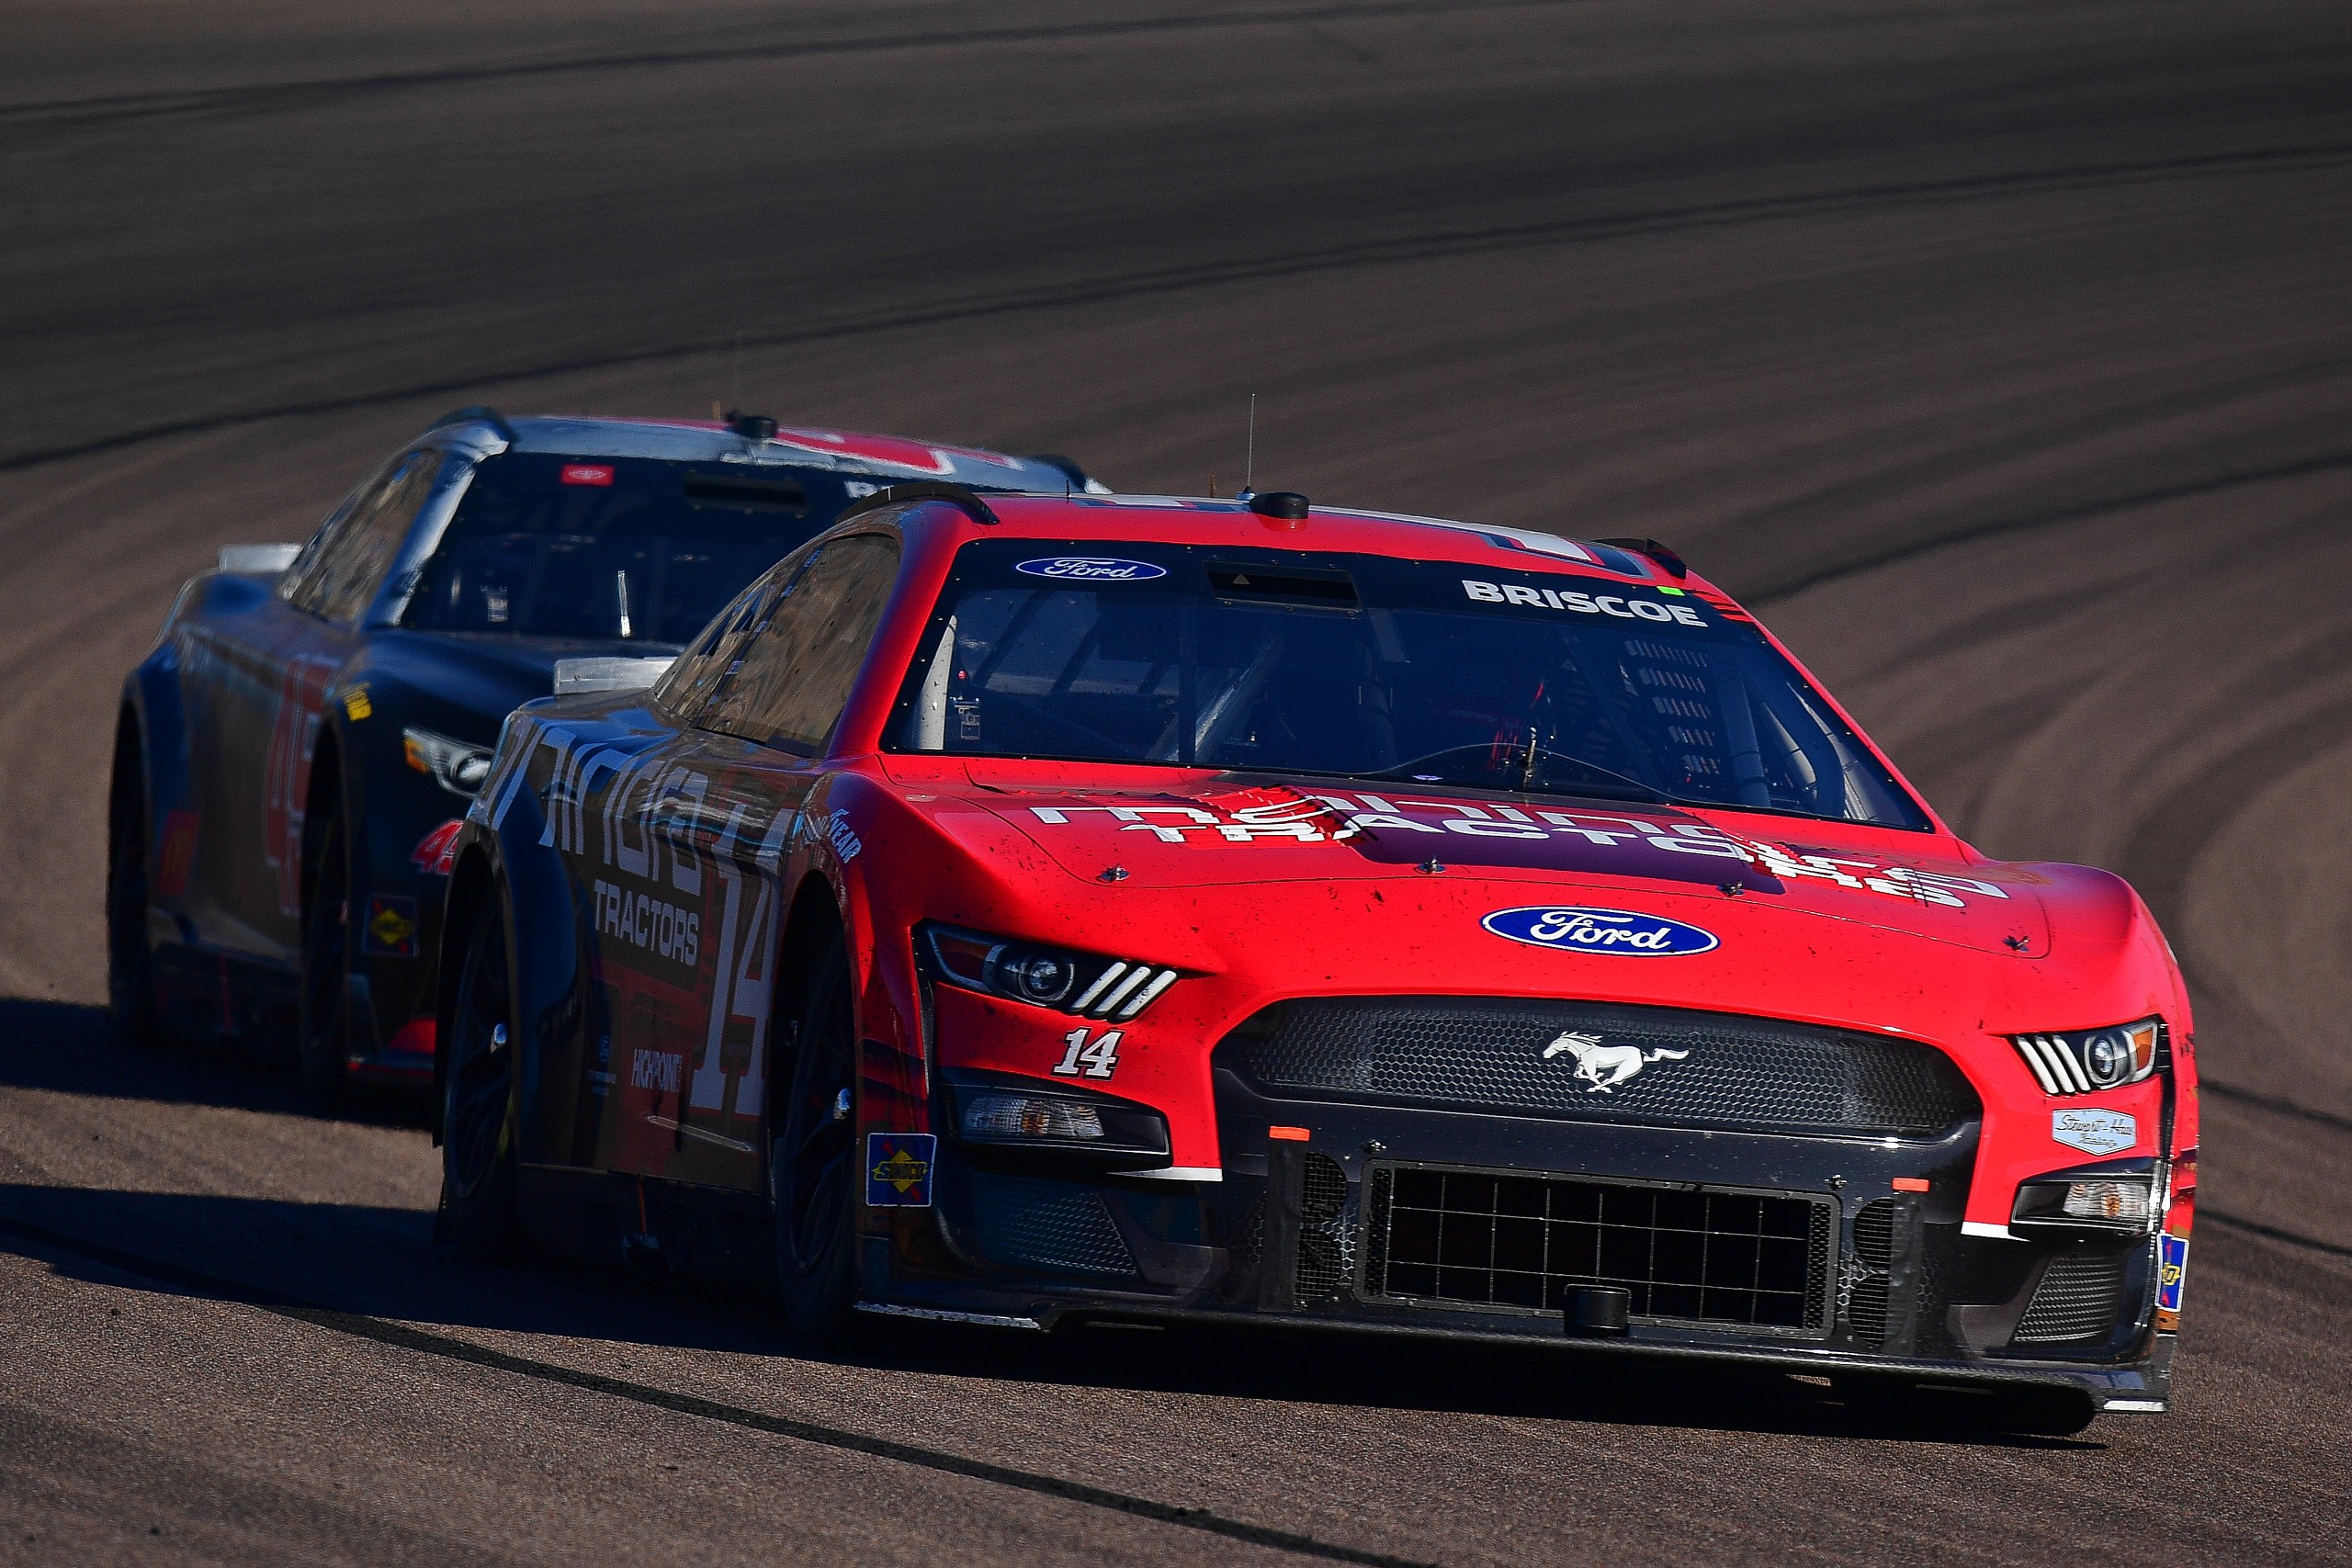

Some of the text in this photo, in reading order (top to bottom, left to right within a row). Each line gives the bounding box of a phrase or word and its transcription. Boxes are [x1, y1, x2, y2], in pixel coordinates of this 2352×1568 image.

[1044, 558, 1139, 579] Ford
[1461, 579, 1708, 627] BRISCOE
[1119, 813, 1965, 908] TRACTORS
[594, 878, 699, 966] TRACTORS
[1529, 910, 1673, 950] Ford
[688, 803, 792, 1117] 14
[1053, 1027, 1125, 1079] 14
